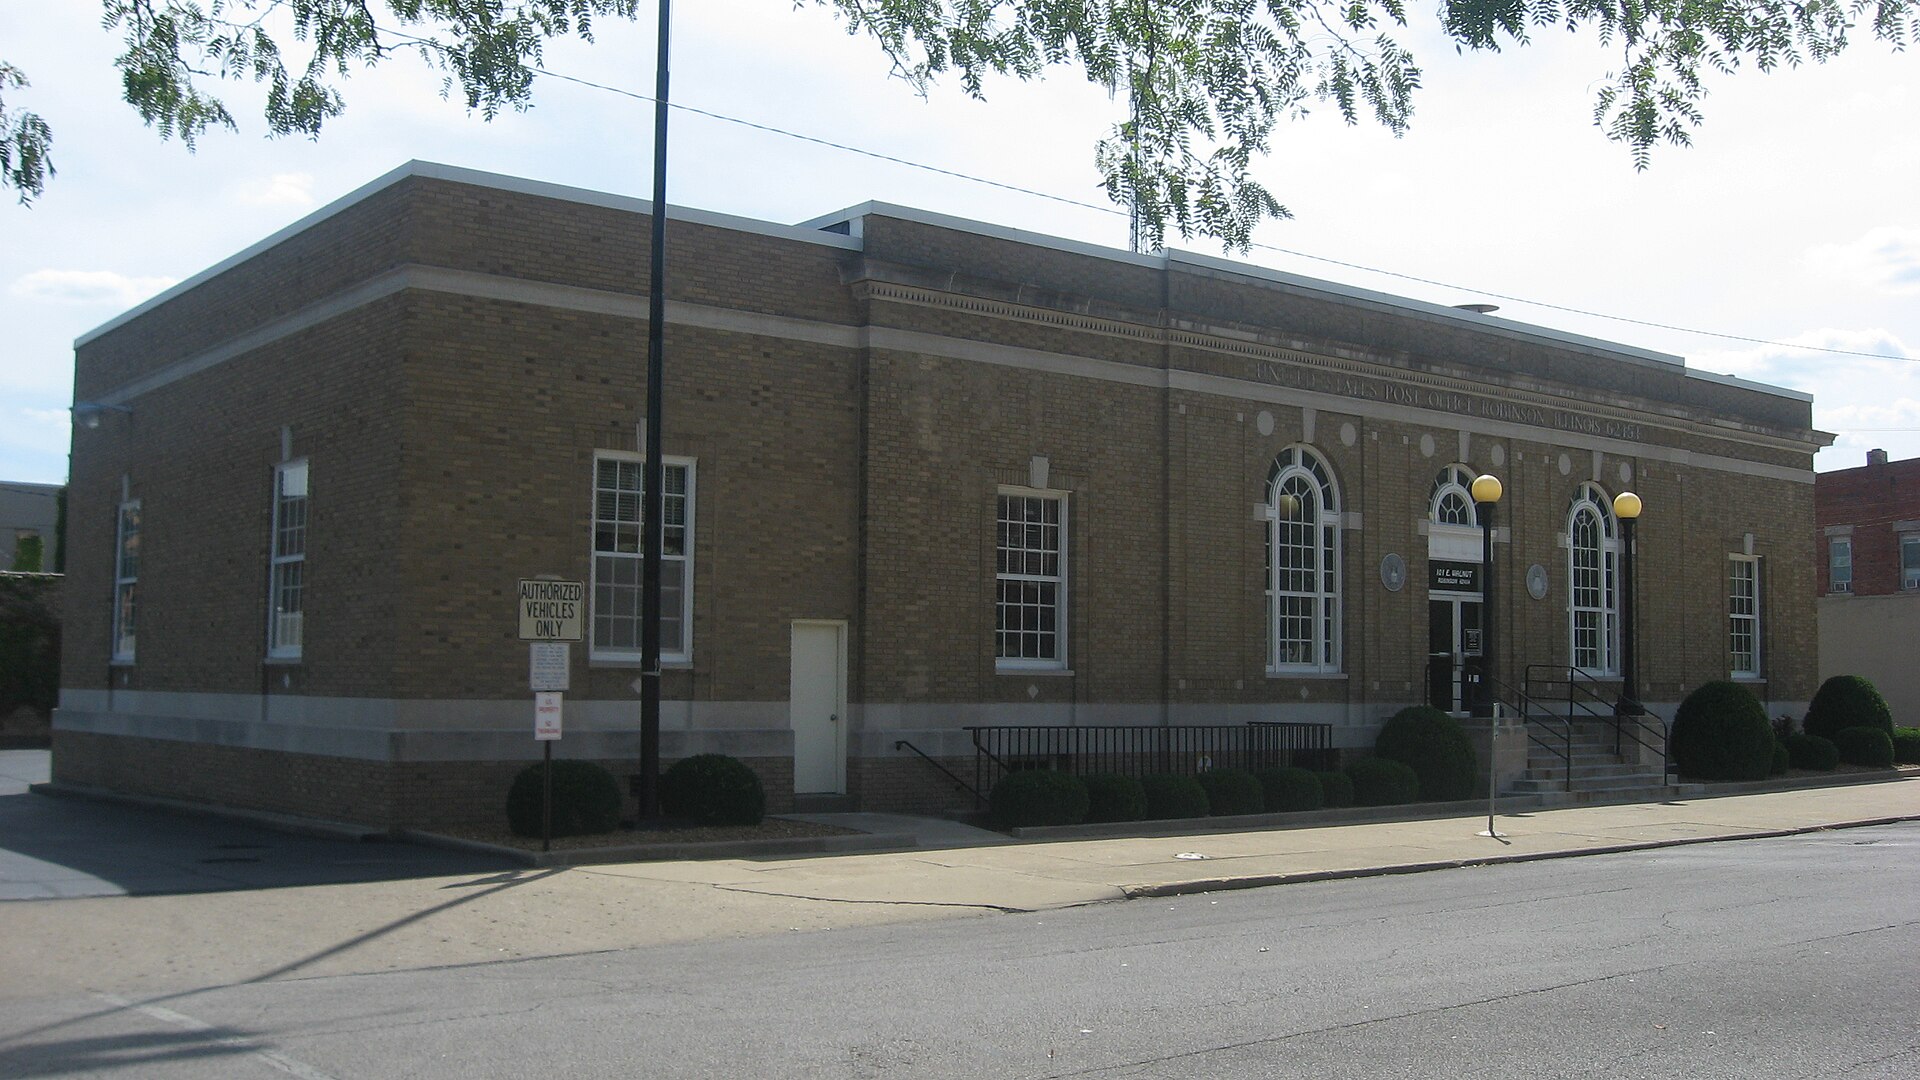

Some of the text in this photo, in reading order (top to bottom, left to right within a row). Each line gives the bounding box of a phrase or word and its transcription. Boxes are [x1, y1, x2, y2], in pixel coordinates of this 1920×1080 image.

[1385, 384, 1419, 403] POST
[1428, 391, 1473, 412] OFFICE
[1482, 399, 1544, 424] ROBINSON
[1554, 411, 1600, 432] ILLINOIS
[1451, 569, 1473, 578] WALNUT
[521, 583, 582, 601] AUTHORIZED
[527, 601, 575, 619] VEHICLES
[536, 619, 564, 637] ONLY
